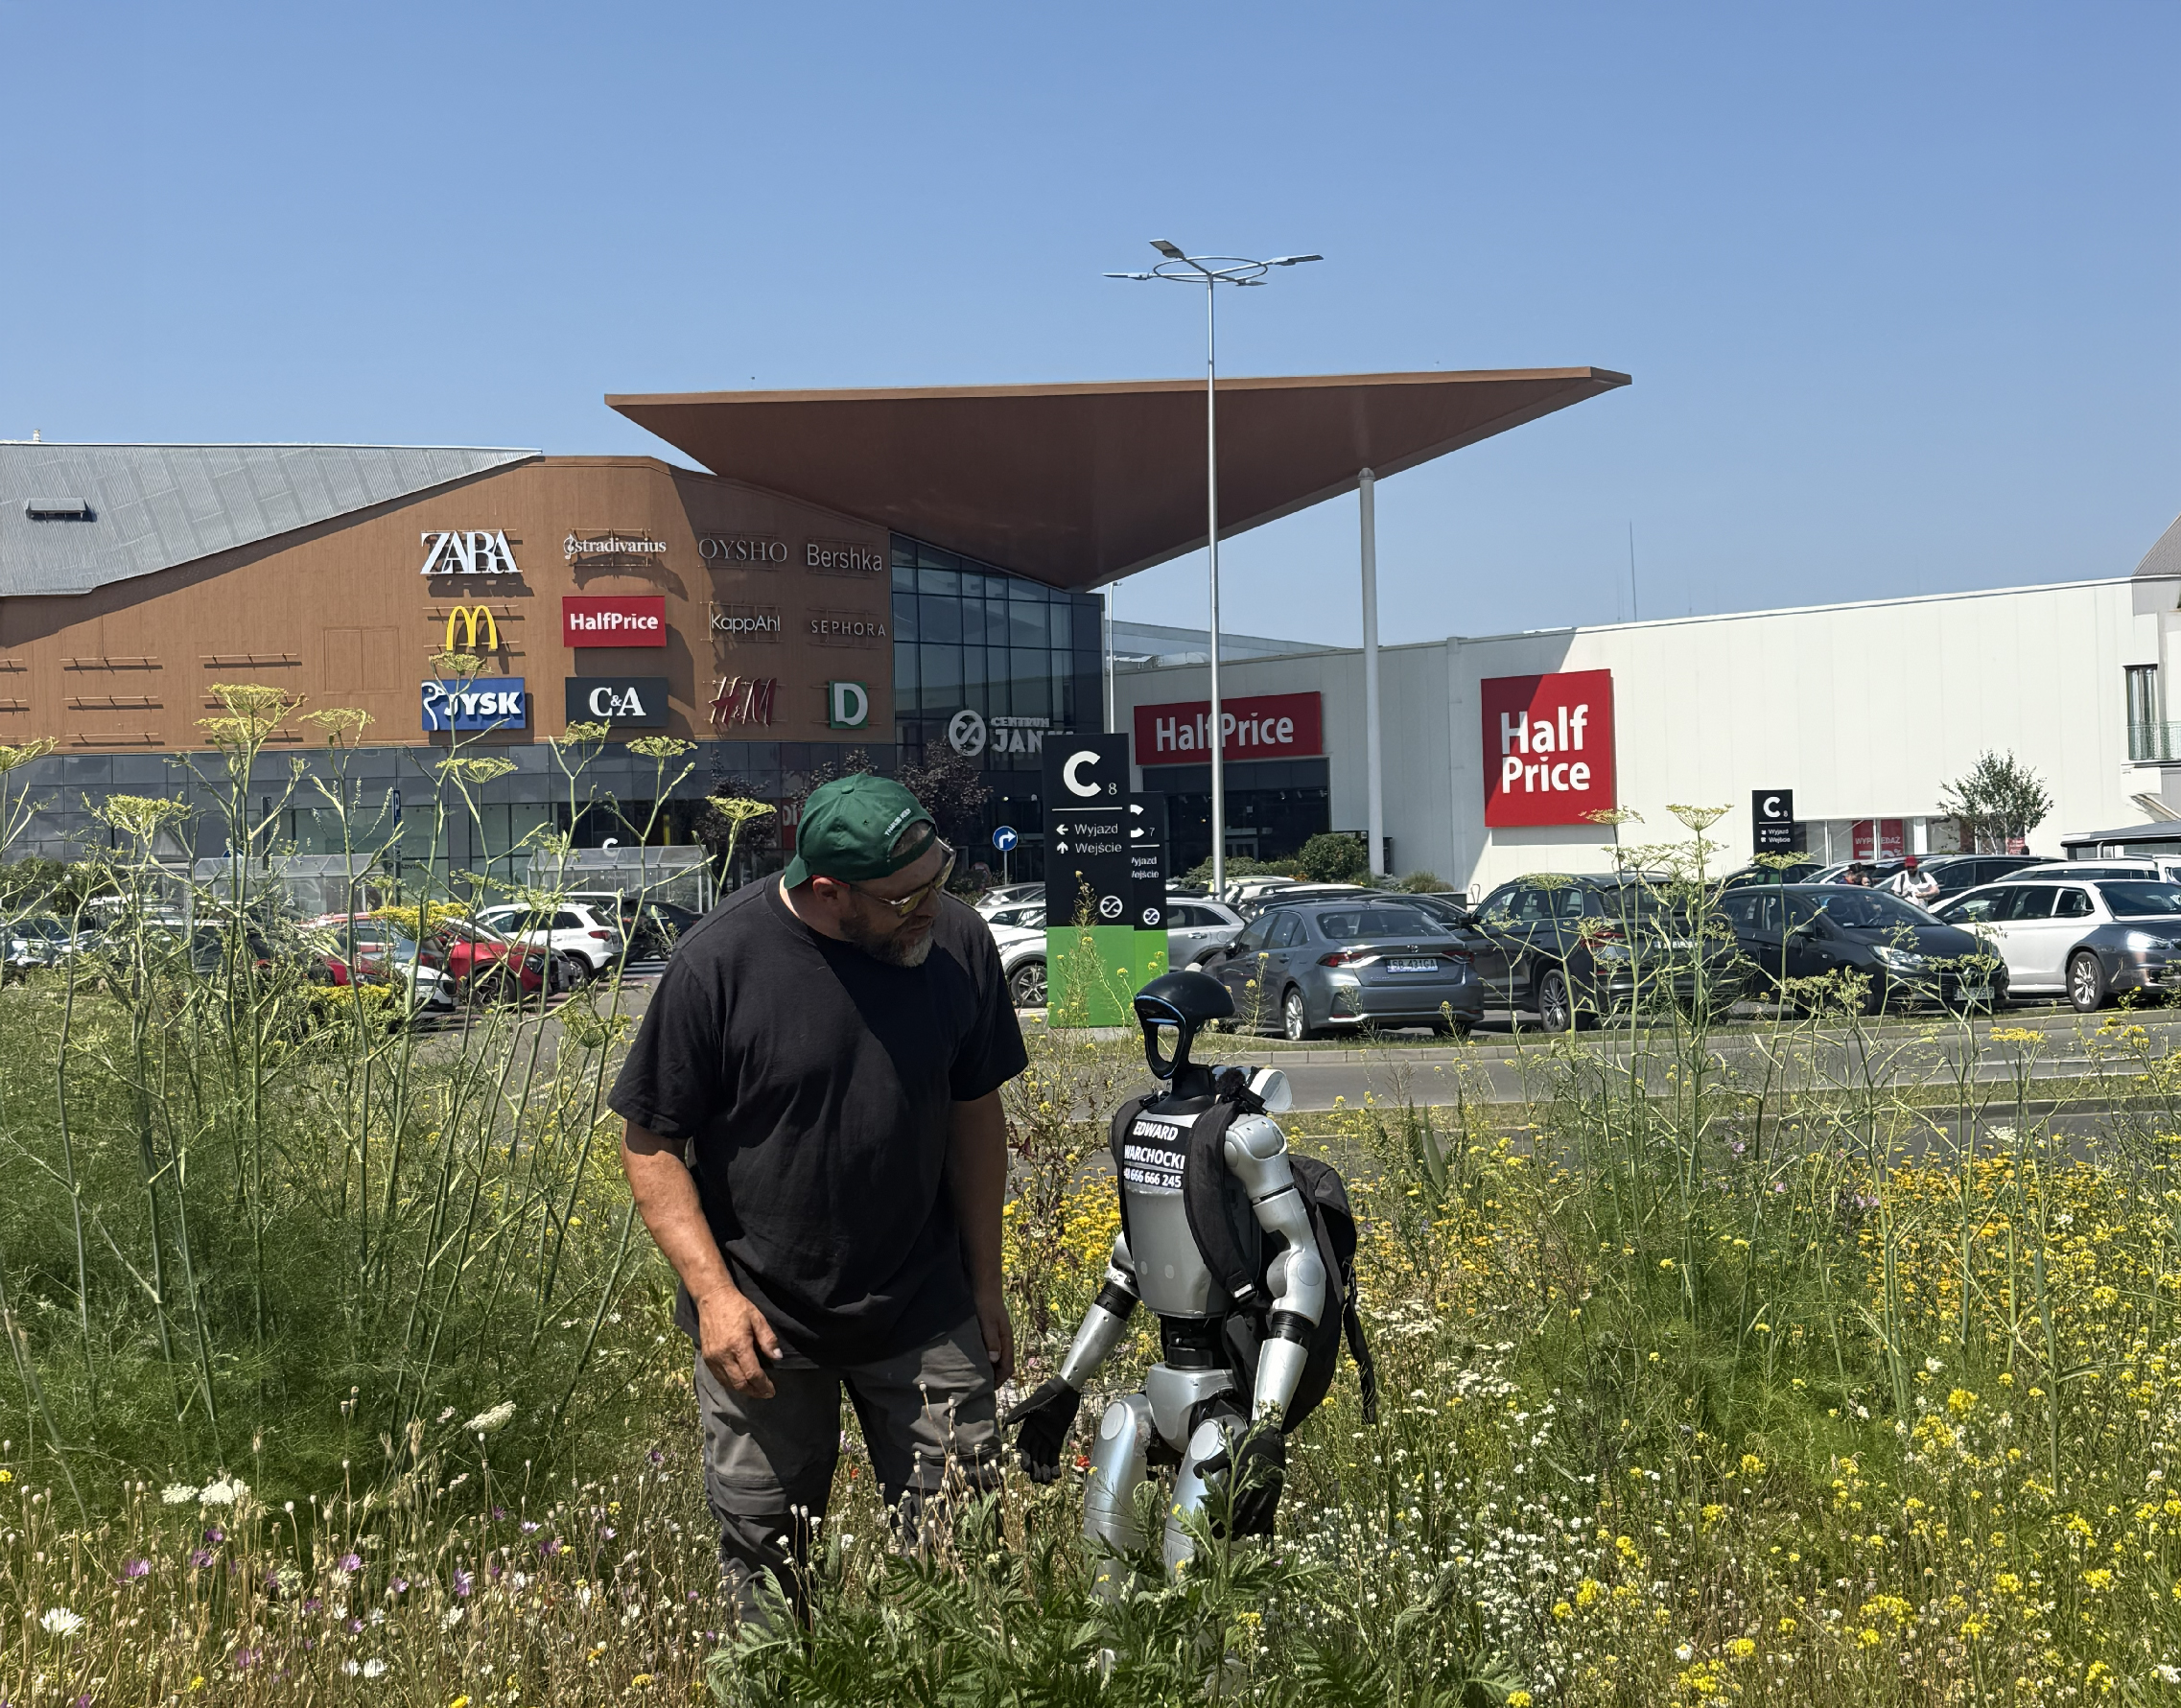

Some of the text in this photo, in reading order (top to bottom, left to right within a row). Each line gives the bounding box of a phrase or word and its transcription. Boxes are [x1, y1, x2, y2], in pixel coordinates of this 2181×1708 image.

[420, 529, 523, 574] ZARA
[698, 538, 788, 563] OYSHO
[807, 543, 882, 572] Bershka
[570, 612, 659, 630] HalfPrice
[711, 613, 781, 634] KappAhl
[811, 620, 886, 637] SEPHORA
[589, 687, 646, 717] C&A
[708, 675, 778, 727] H&M
[833, 683, 868, 726] D
[991, 716, 1050, 728] CENTRUM
[1501, 704, 1588, 755] Half
[992, 729, 1074, 753] JAN
[1063, 750, 1117, 797] C 8
[1502, 756, 1590, 794] Price
[1763, 796, 1781, 817] C
[1074, 823, 1118, 836] Wyjazd
[1149, 827, 1156, 837] 7
[1855, 835, 1901, 844] WYPEDAŻ
[602, 837, 619, 857] C
[1075, 842, 1122, 855] Wejście
[1133, 1120, 1179, 1141] EDWARD
[1144, 1171, 1161, 1185] 666
[1161, 1174, 1182, 1188] 245
